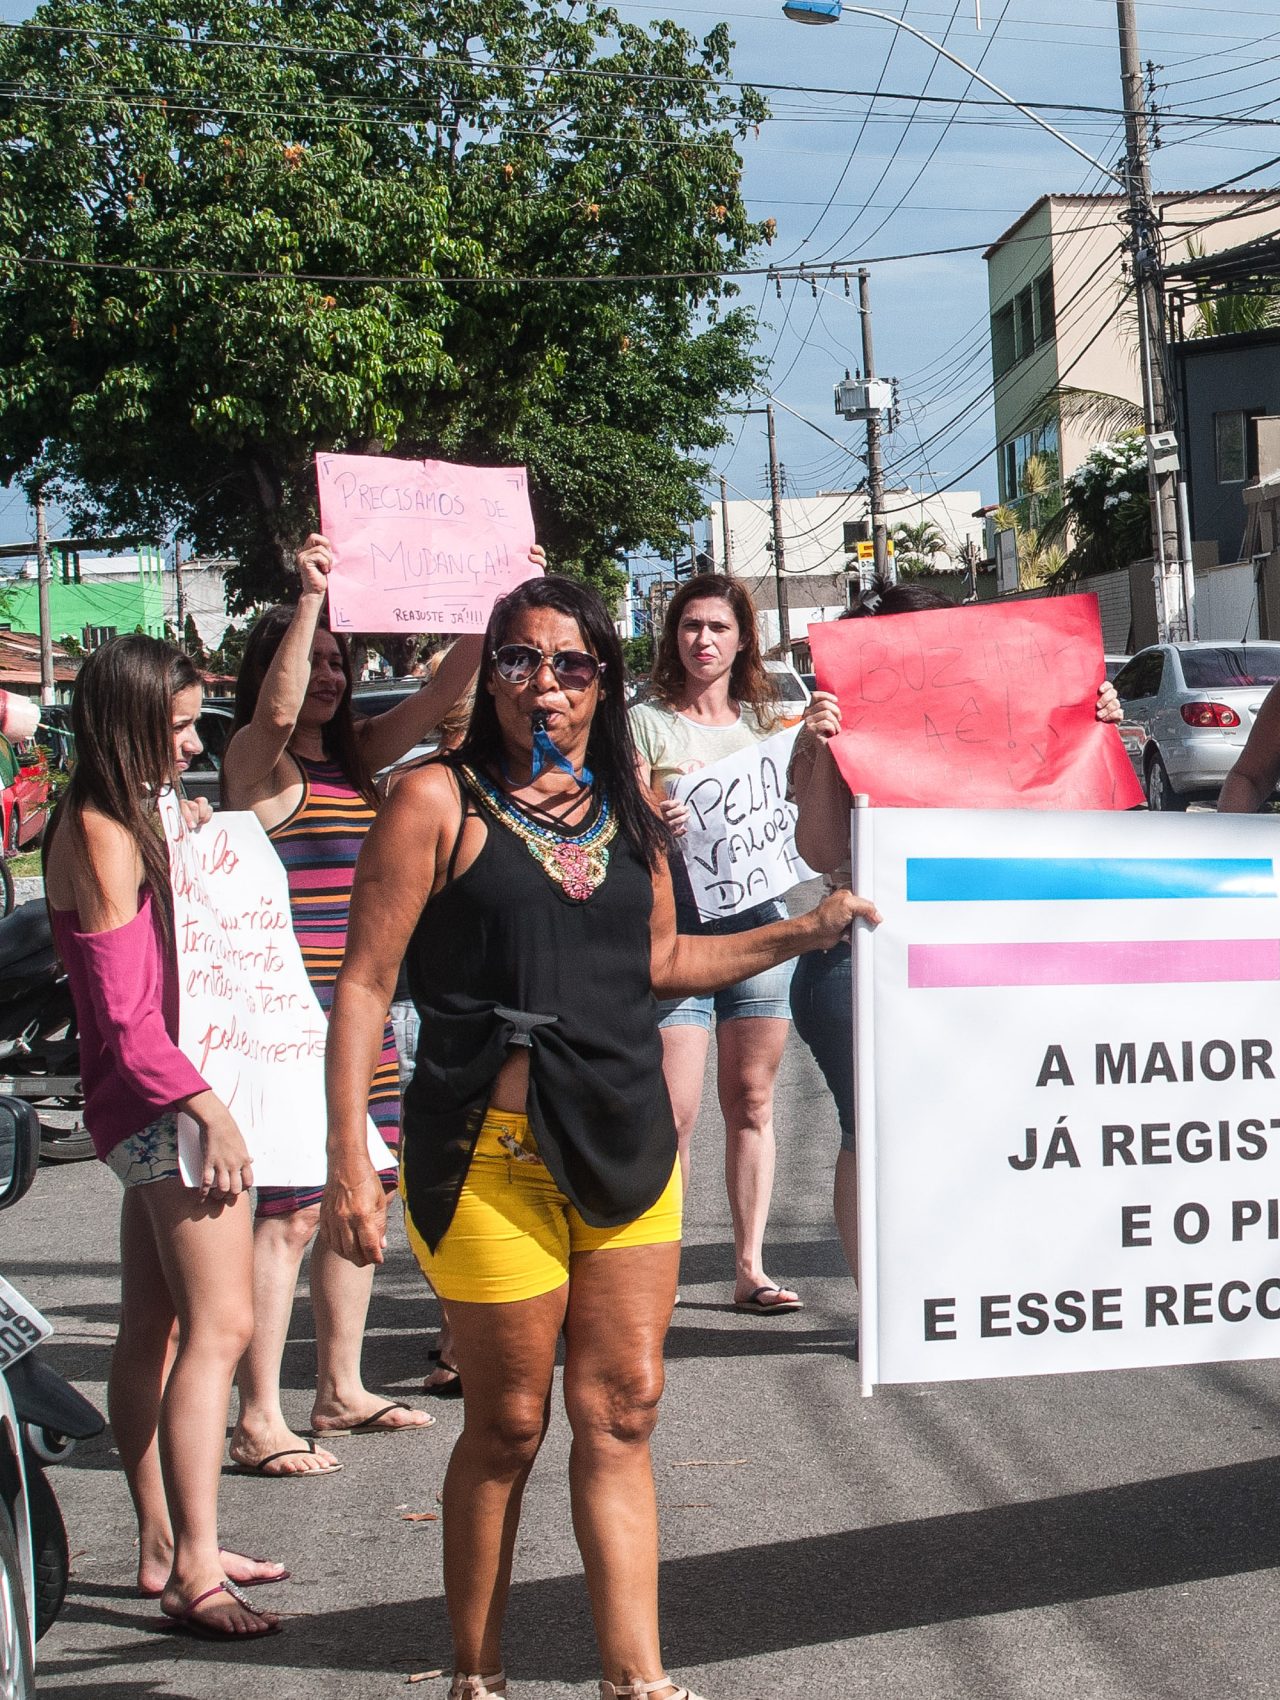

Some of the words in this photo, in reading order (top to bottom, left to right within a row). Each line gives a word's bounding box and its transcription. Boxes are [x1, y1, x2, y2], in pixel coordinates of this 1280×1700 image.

[334, 471, 466, 516] PRECISAMOS
[480, 498, 509, 518] DE
[393, 609, 444, 623] REAJUSTE
[684, 757, 781, 830] PELA
[693, 805, 798, 876] VALORI
[704, 867, 769, 909] DA
[1036, 1045, 1074, 1087] A
[1096, 1039, 1274, 1085] MAIOR
[1008, 1116, 1080, 1171] JÁ
[1122, 1205, 1152, 1248] E
[1173, 1202, 1210, 1245] O
[924, 1297, 957, 1341] E
[981, 1287, 1123, 1339] ESSE
